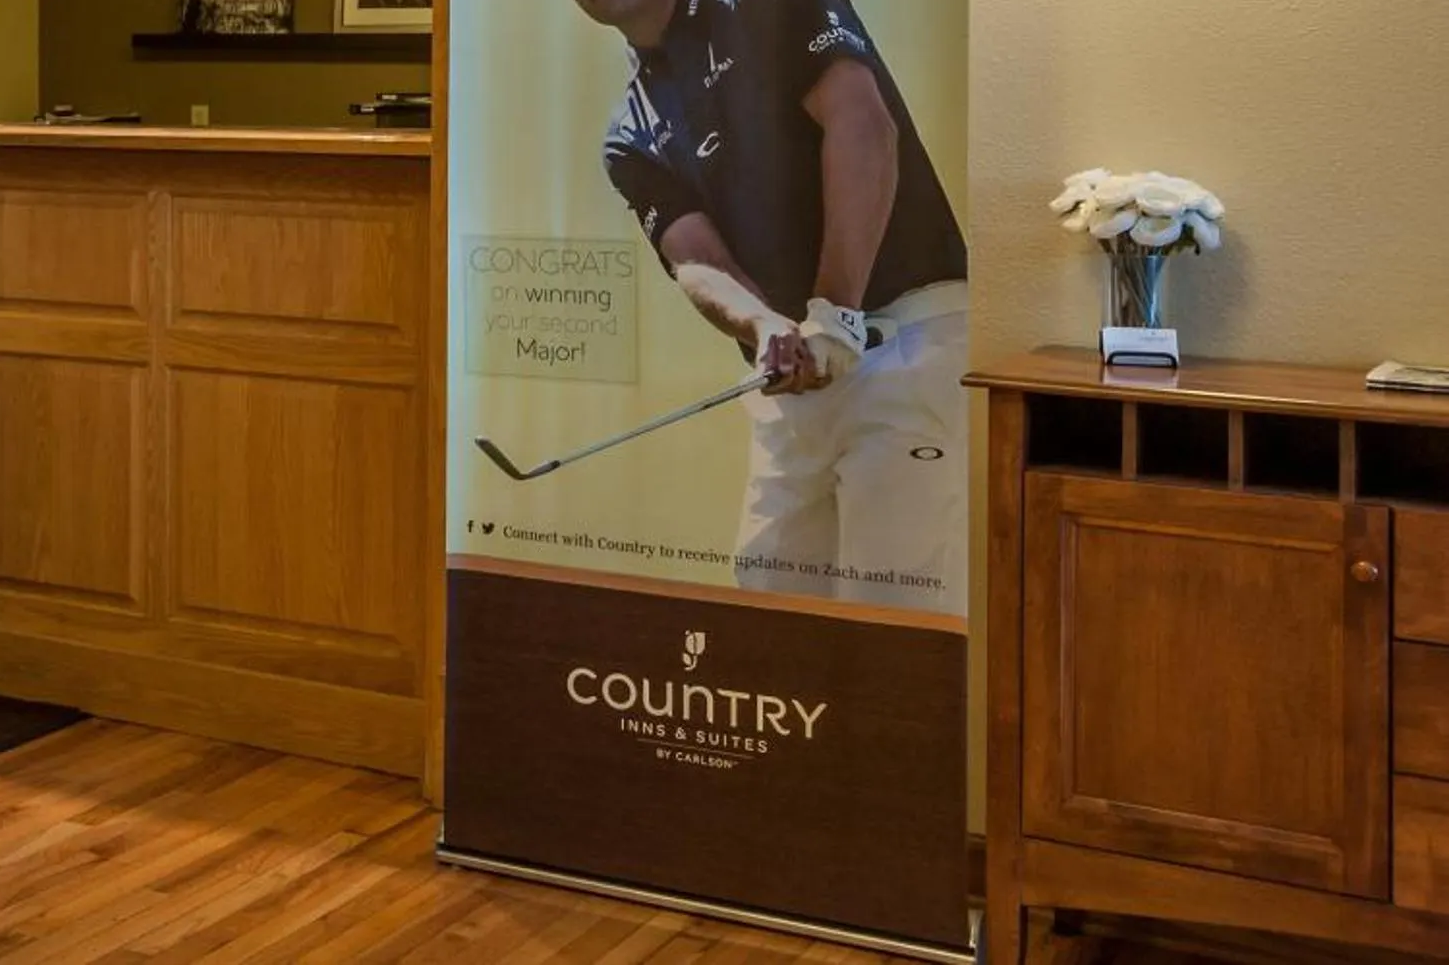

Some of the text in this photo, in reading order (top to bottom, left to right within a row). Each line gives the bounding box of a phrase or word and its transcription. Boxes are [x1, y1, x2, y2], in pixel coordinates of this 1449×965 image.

[469, 247, 633, 278] CONGRATS
[490, 285, 612, 312] on winning
[484, 314, 618, 336] your second
[516, 337, 586, 366] Major!
[503, 525, 558, 544] Connect
[562, 532, 594, 549] with
[598, 537, 654, 559] Country
[659, 544, 675, 558] to
[677, 547, 730, 566] receive
[735, 552, 794, 571] updates
[799, 563, 818, 575] on
[823, 564, 859, 581] Zach
[863, 568, 894, 584] and
[900, 575, 947, 590] more.
[620, 718, 768, 753] INNS & SUITES
[656, 747, 671, 760] BY
